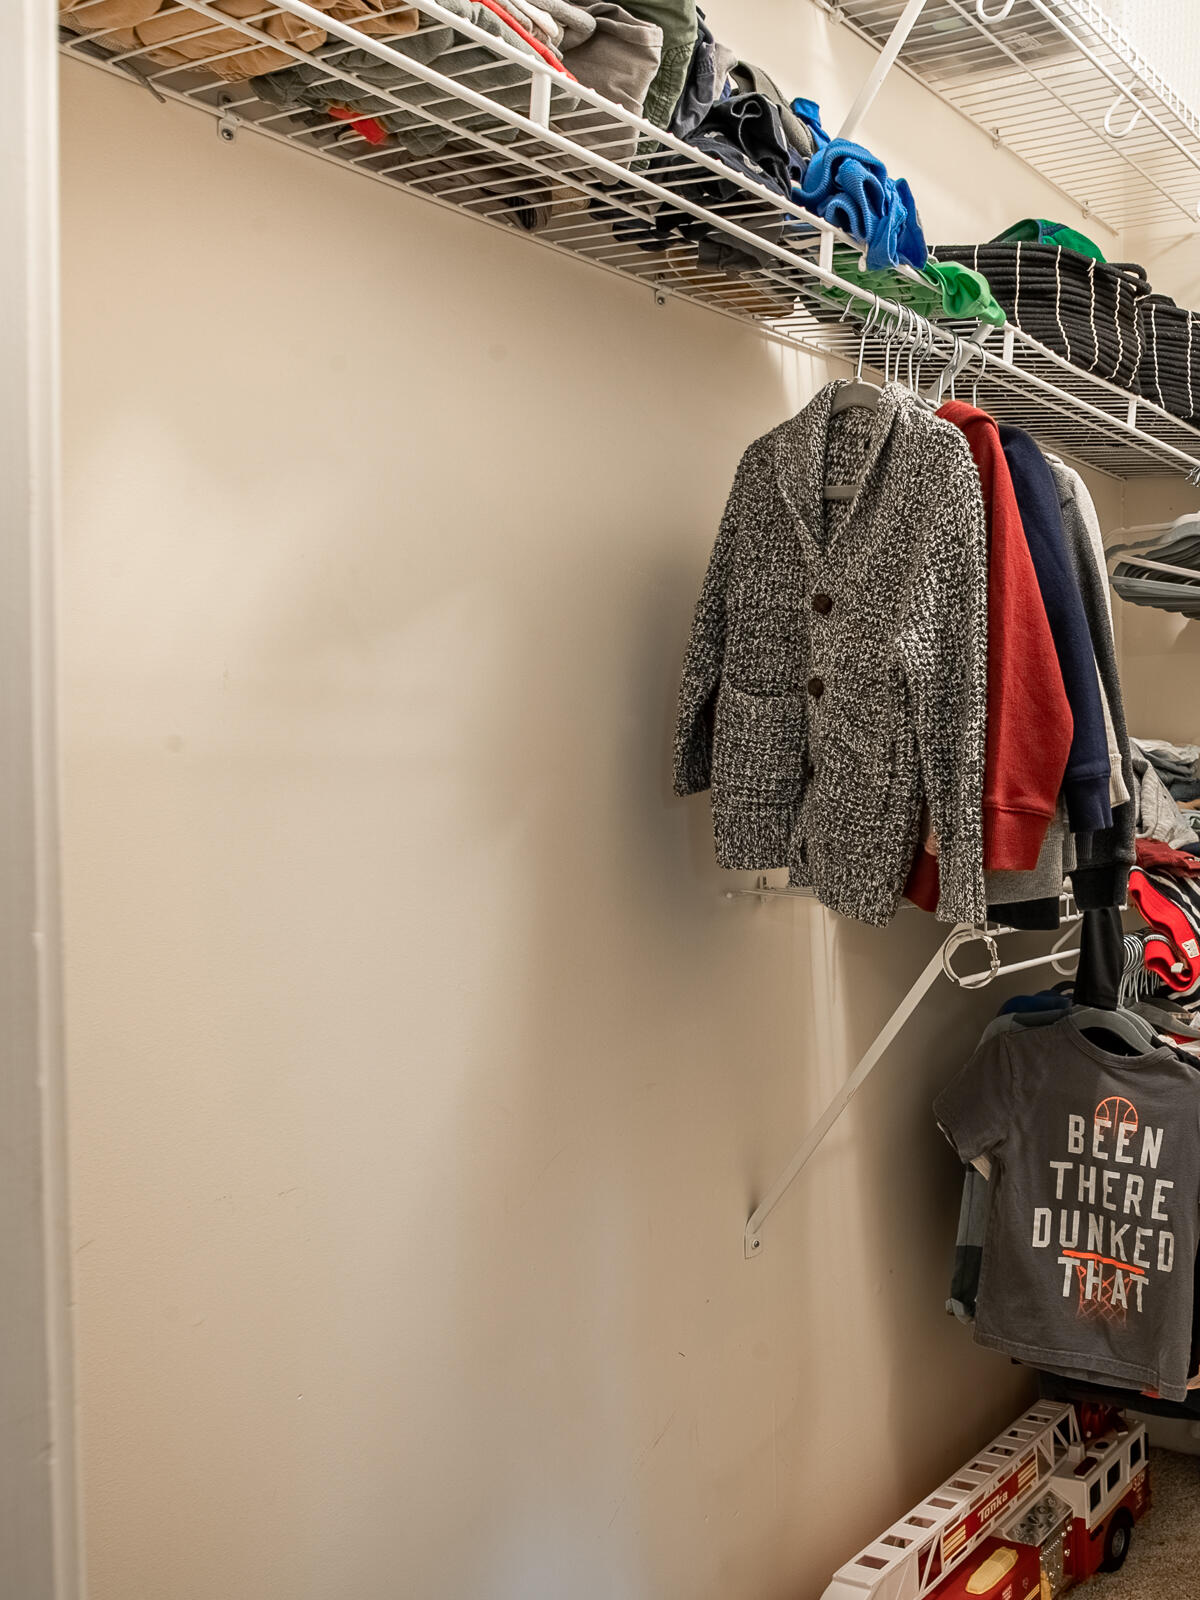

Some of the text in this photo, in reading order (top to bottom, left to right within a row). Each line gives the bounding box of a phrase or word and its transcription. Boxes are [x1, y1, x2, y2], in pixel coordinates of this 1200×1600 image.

[1068, 1114, 1164, 1169] BEEN
[1050, 1160, 1174, 1222] THERE
[1032, 1207, 1175, 1273] DUNKED
[1057, 1256, 1149, 1312] THAT
[977, 1490, 1009, 1523] Tonka
